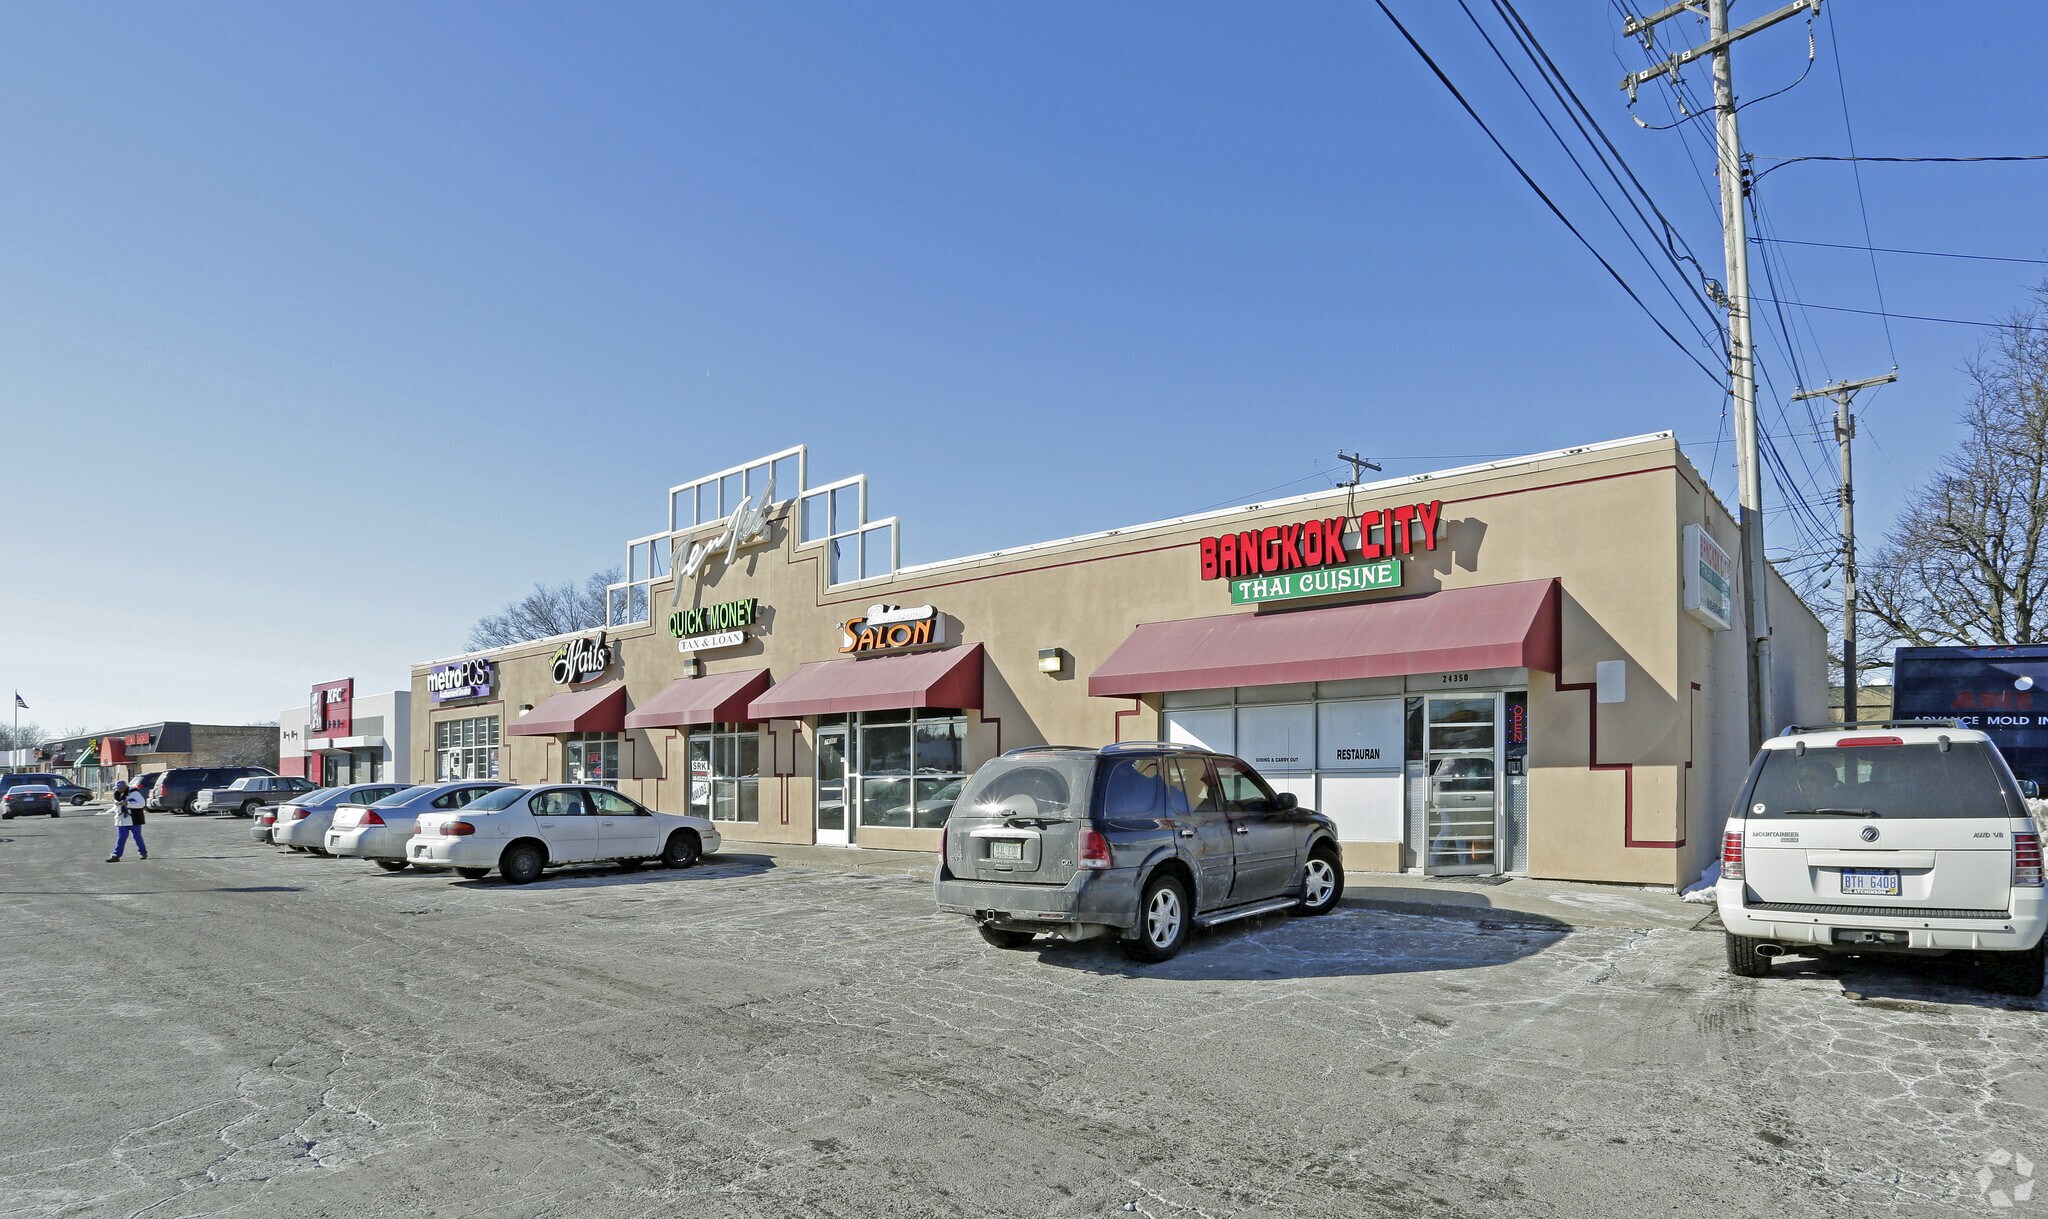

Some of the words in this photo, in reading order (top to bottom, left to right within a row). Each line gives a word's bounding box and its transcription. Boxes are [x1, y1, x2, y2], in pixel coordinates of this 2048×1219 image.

[1200, 515, 1346, 581] BANGKOK
[1361, 499, 1442, 560] CITY
[1239, 576, 1297, 600] THAI
[1299, 564, 1393, 592] CUISINE
[669, 607, 706, 638] QUICK
[710, 598, 756, 630] MONEY
[681, 639, 700, 650] TAX
[702, 638, 710, 648] &
[712, 634, 741, 646] LOAN
[838, 617, 933, 653] SALON
[553, 631, 606, 685] Nails
[1442, 673, 1469, 683] 24350
[326, 687, 343, 703] KFC
[1513, 705, 1523, 743] OPEN
[1914, 716, 1979, 725] ADVACE
[1987, 716, 2030, 725] MOLD
[1337, 749, 1380, 761] RESTAURAN
[692, 762, 707, 770] SRK
[1845, 876, 1864, 888] BTH
[1870, 876, 1896, 888] 6408
